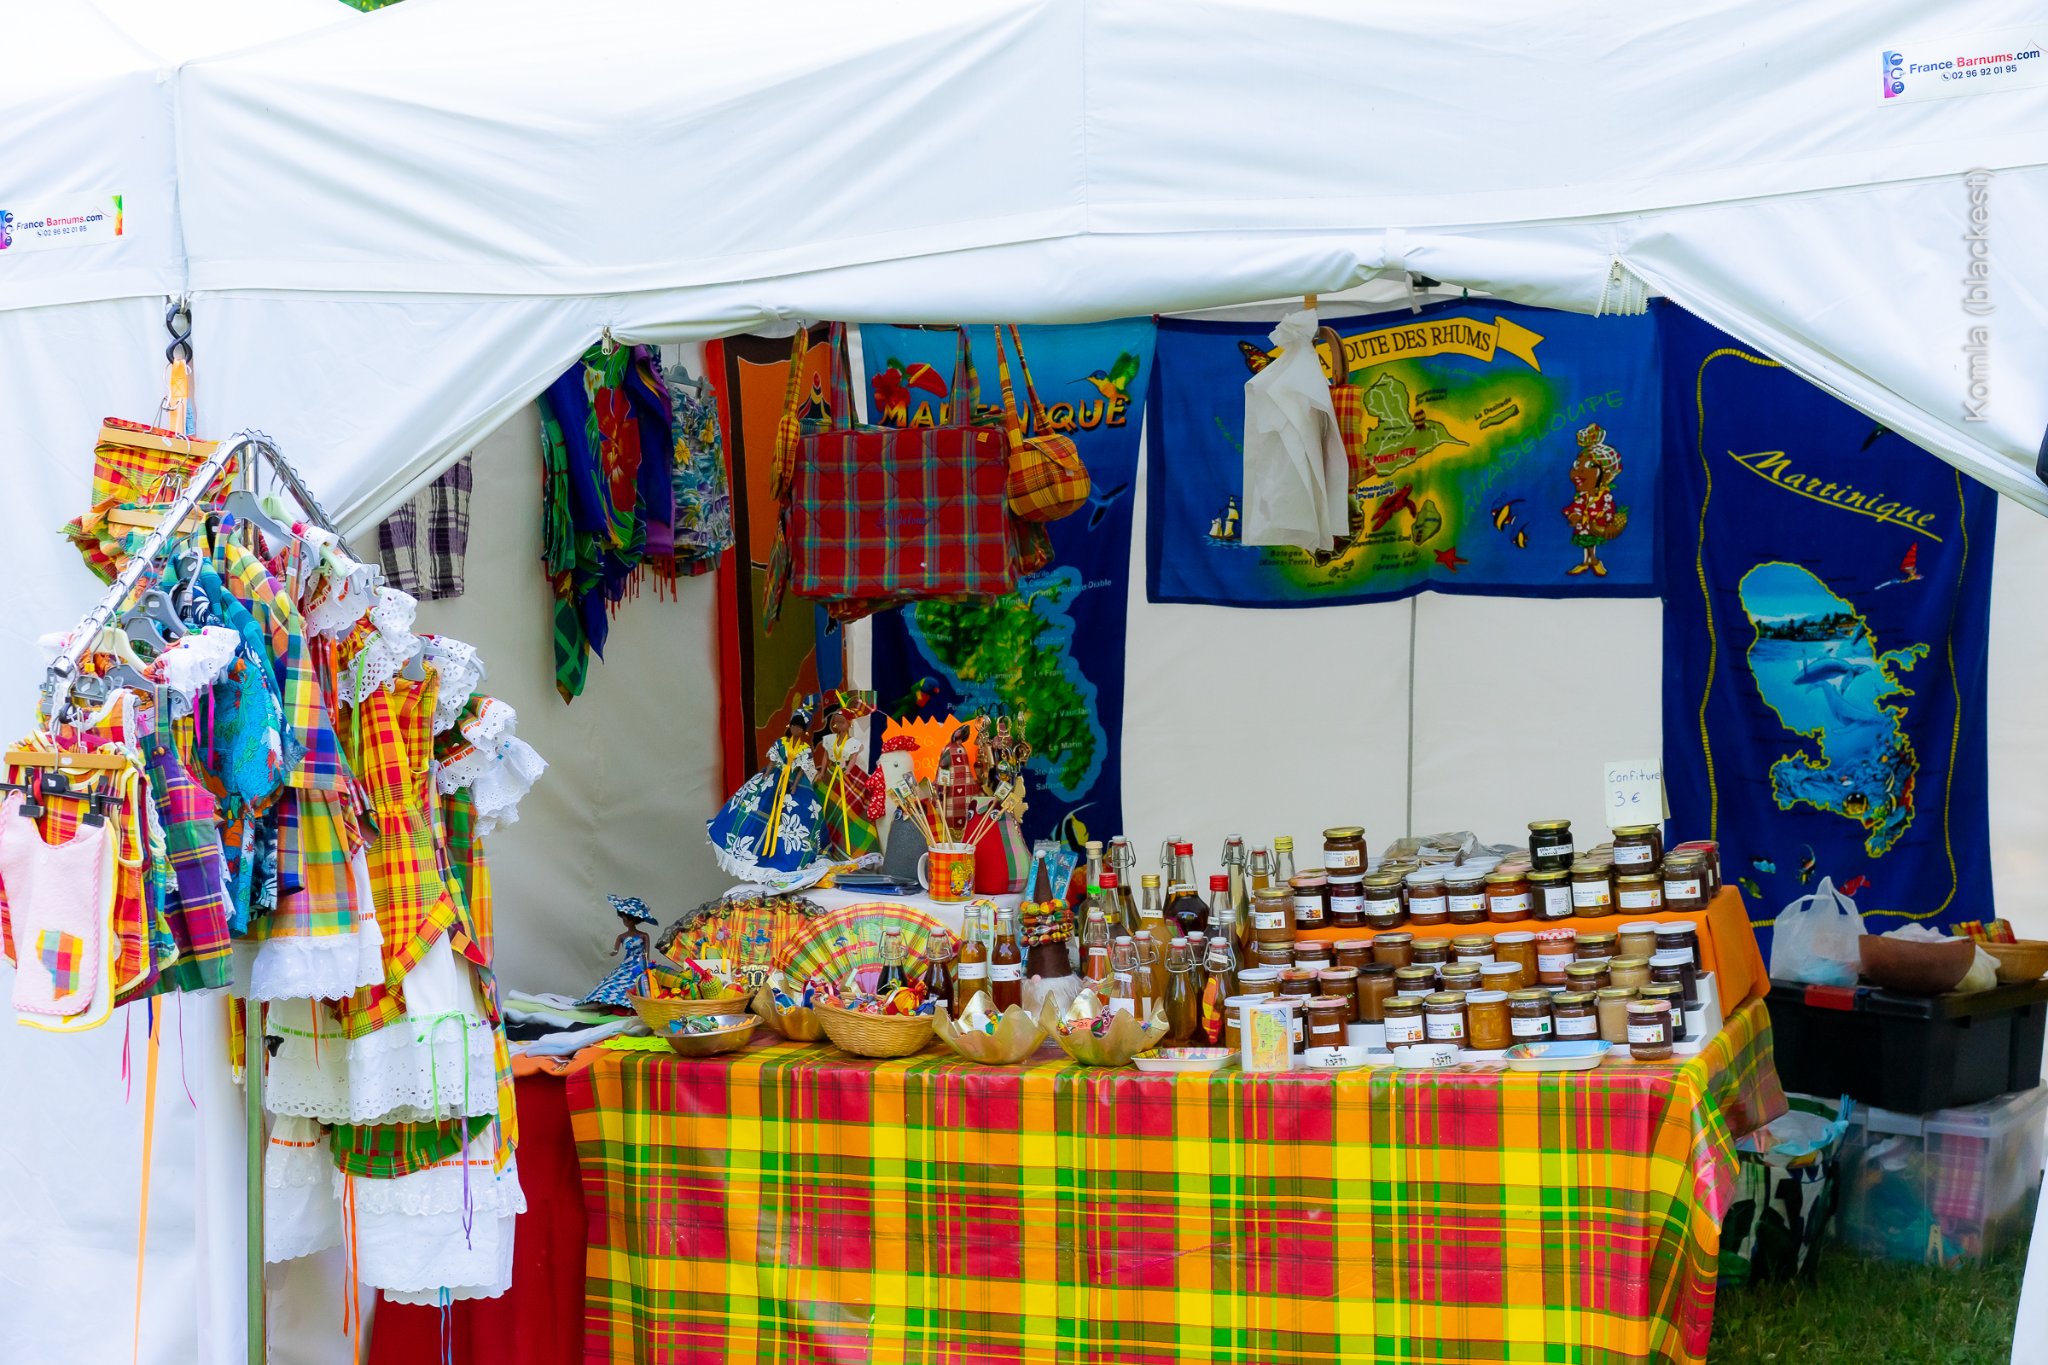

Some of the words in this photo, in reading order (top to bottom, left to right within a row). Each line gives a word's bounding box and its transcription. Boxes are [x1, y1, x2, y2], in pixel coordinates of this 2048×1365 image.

[1909, 59, 1953, 75] France
[1956, 49, 2041, 68] Barnums.com
[1952, 71, 1964, 80] 02
[1966, 69, 1978, 78] 96
[1980, 67, 1992, 77] 92
[1993, 65, 2003, 75] 01
[2005, 64, 2018, 73] 95
[16, 219, 44, 231] France
[46, 213, 104, 227] Barnums.com
[1344, 334, 1390, 364] OUTE
[1391, 328, 1428, 352] DES
[1430, 324, 1492, 353] RHUMS
[1463, 389, 1625, 526] GUADELOUPE
[1729, 449, 1938, 530] Martinique
[1614, 790, 1626, 808] 3
[1631, 791, 1641, 804] €
